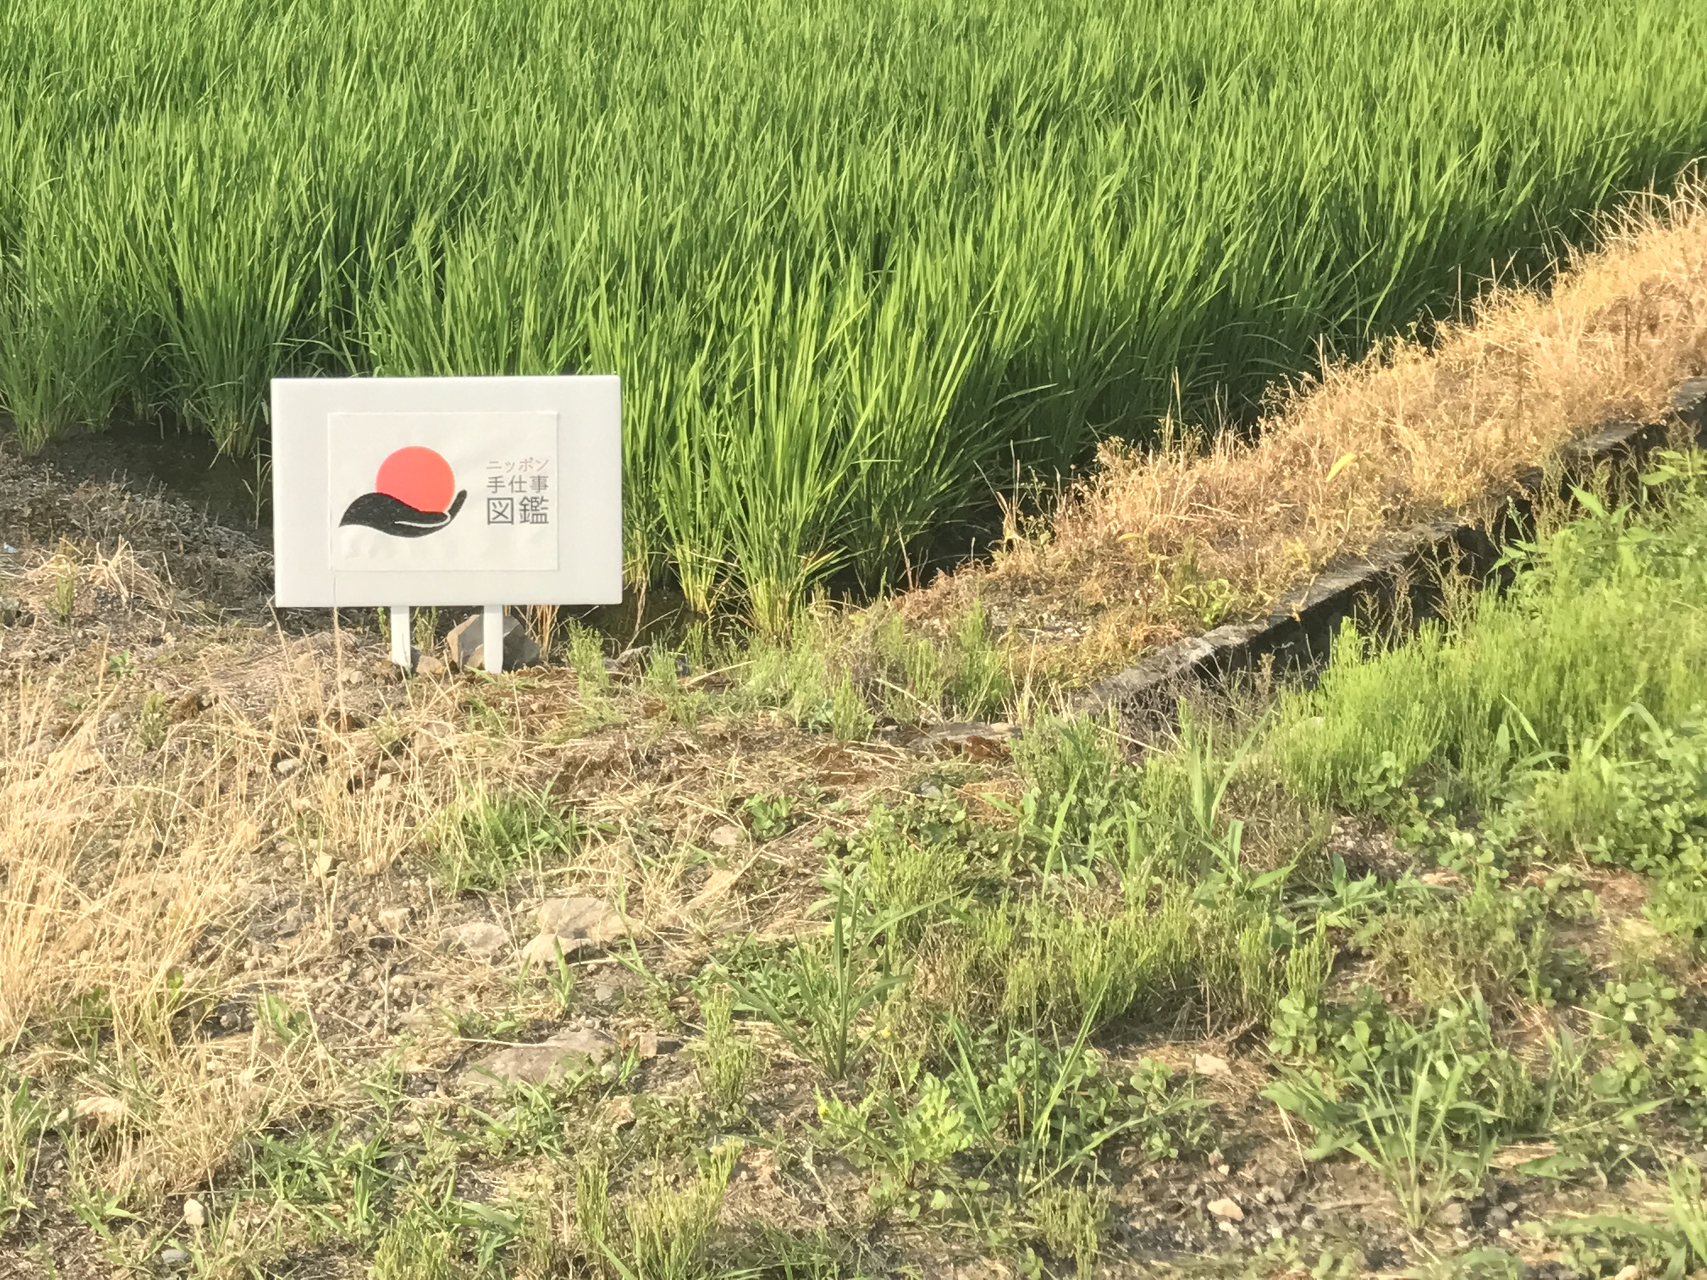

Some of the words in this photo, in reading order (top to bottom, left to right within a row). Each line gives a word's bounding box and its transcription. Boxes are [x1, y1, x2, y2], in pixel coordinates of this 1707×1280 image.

[485, 456, 549, 473] ニッポン
[485, 474, 549, 493] 手仕事
[486, 494, 549, 525] 図鑑
